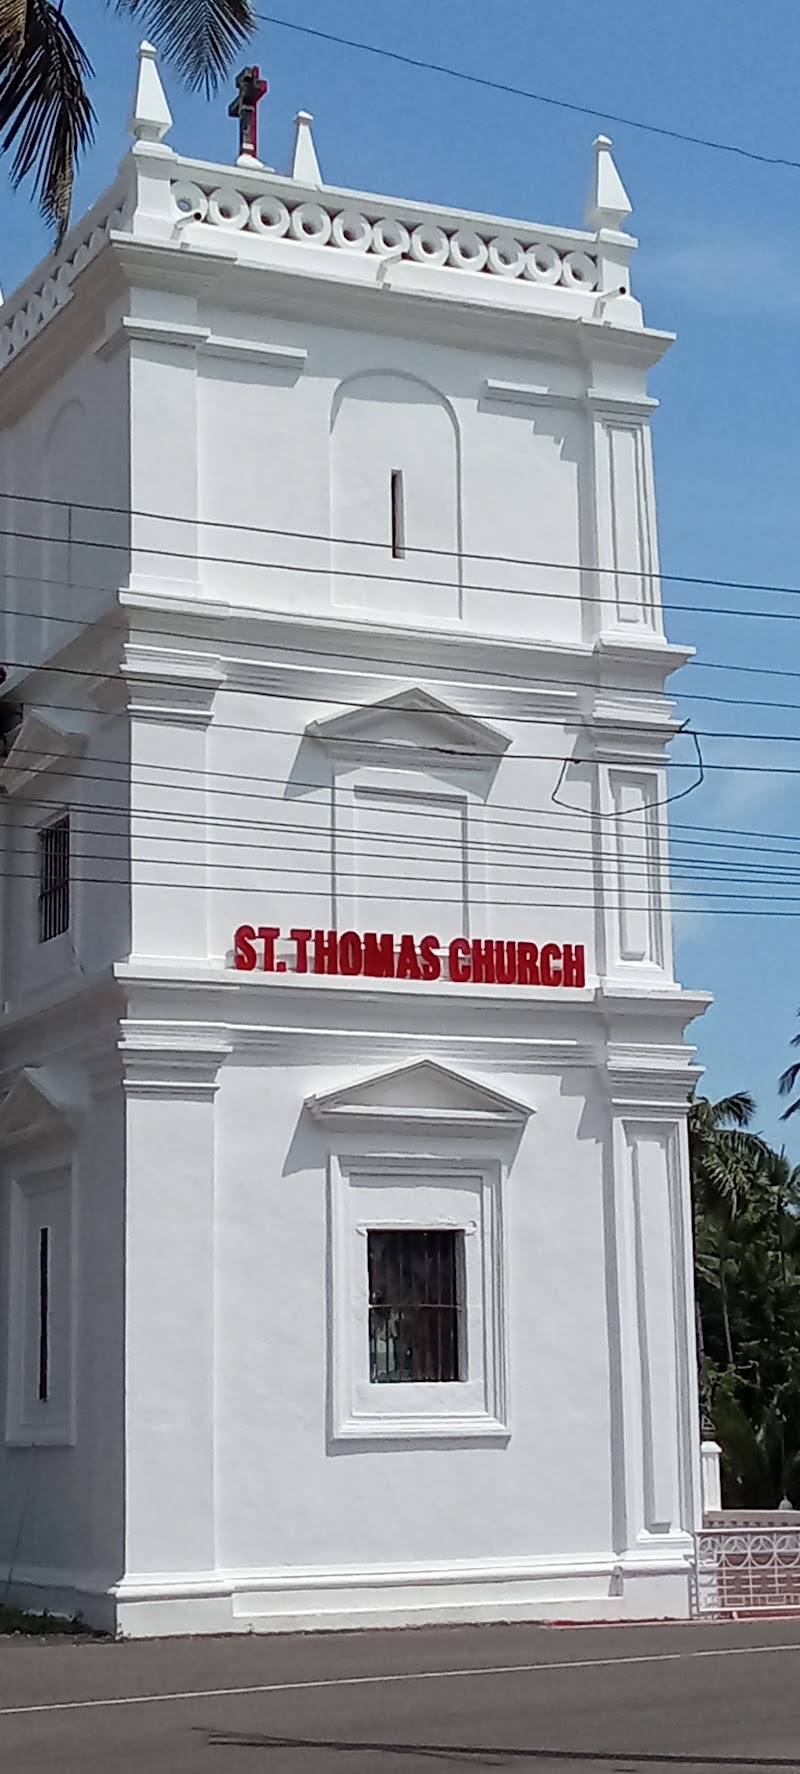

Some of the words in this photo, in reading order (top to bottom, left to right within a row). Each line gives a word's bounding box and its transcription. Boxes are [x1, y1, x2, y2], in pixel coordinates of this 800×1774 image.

[234, 925, 287, 972] ST.
[290, 929, 442, 981] THOMAS
[448, 937, 586, 988] CHURCH
